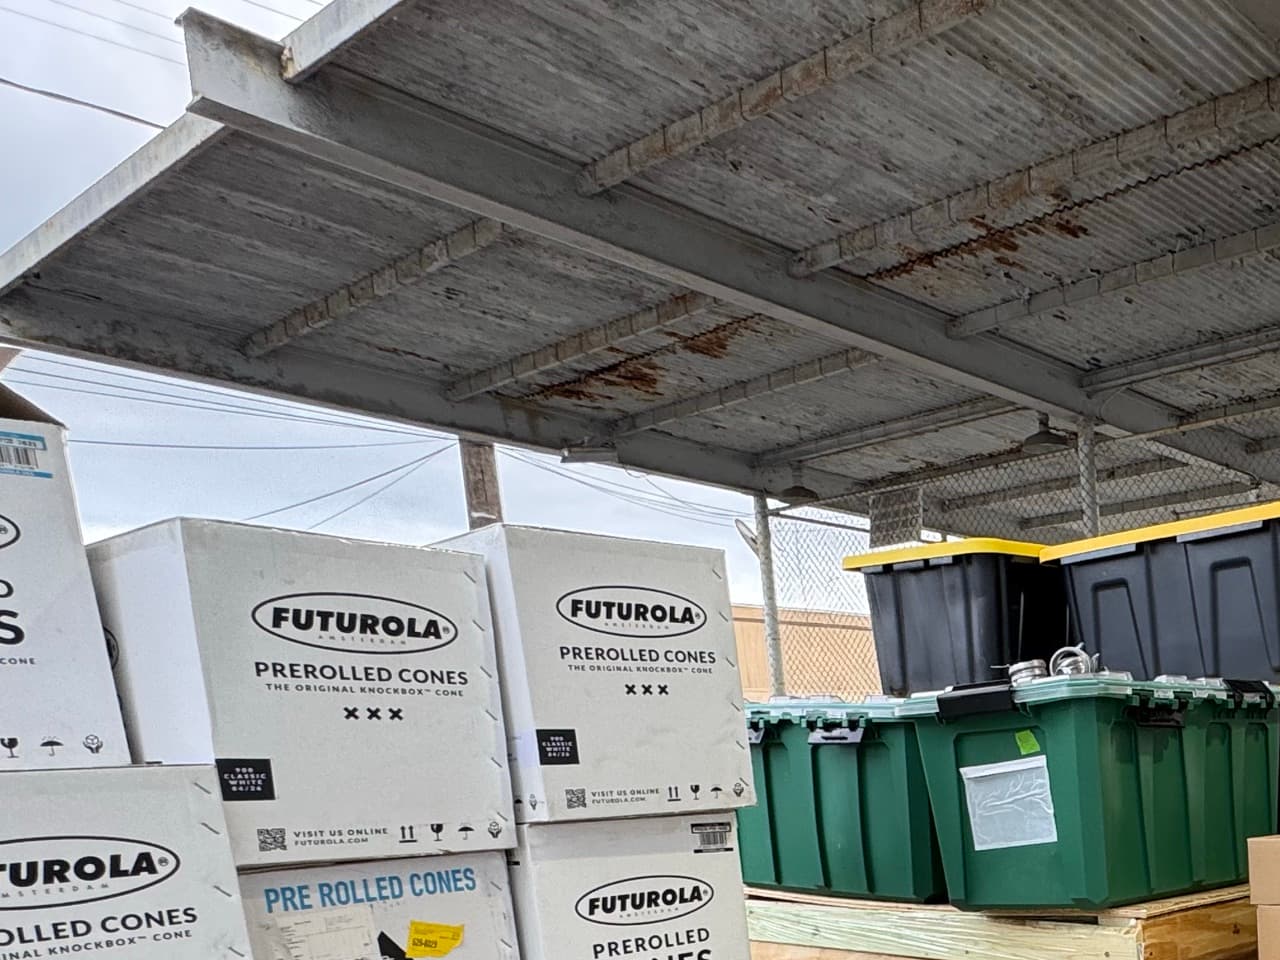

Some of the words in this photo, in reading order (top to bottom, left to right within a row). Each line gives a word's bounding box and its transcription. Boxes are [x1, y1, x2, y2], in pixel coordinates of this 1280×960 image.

[271, 606, 442, 639] FUTUROLA
[570, 599, 696, 625] FUTUROLA
[559, 646, 660, 663] PREROLLED
[664, 650, 717, 664] CONES
[254, 661, 392, 683] PREROLLED
[398, 668, 468, 685] CONES
[589, 665, 634, 673] ORIGINAL
[266, 683, 290, 692] THE
[295, 684, 356, 694] ORIGINAL
[435, 689, 464, 697] CONE
[591, 790, 615, 798] VISIT
[617, 789, 628, 797] US
[629, 788, 660, 796] ONLINE
[293, 829, 325, 839] VISIT
[329, 829, 343, 837] US
[347, 827, 389, 836] ONLINE
[294, 837, 369, 846] FUTUROLA.COM
[264, 885, 313, 913] PRE
[318, 875, 404, 908] ROLLED
[409, 867, 477, 897] CONES
[588, 885, 703, 916] FUTUROLA
[101, 907, 198, 933] CONES
[153, 930, 192, 941] CONE
[593, 927, 710, 960] PREROLLED
